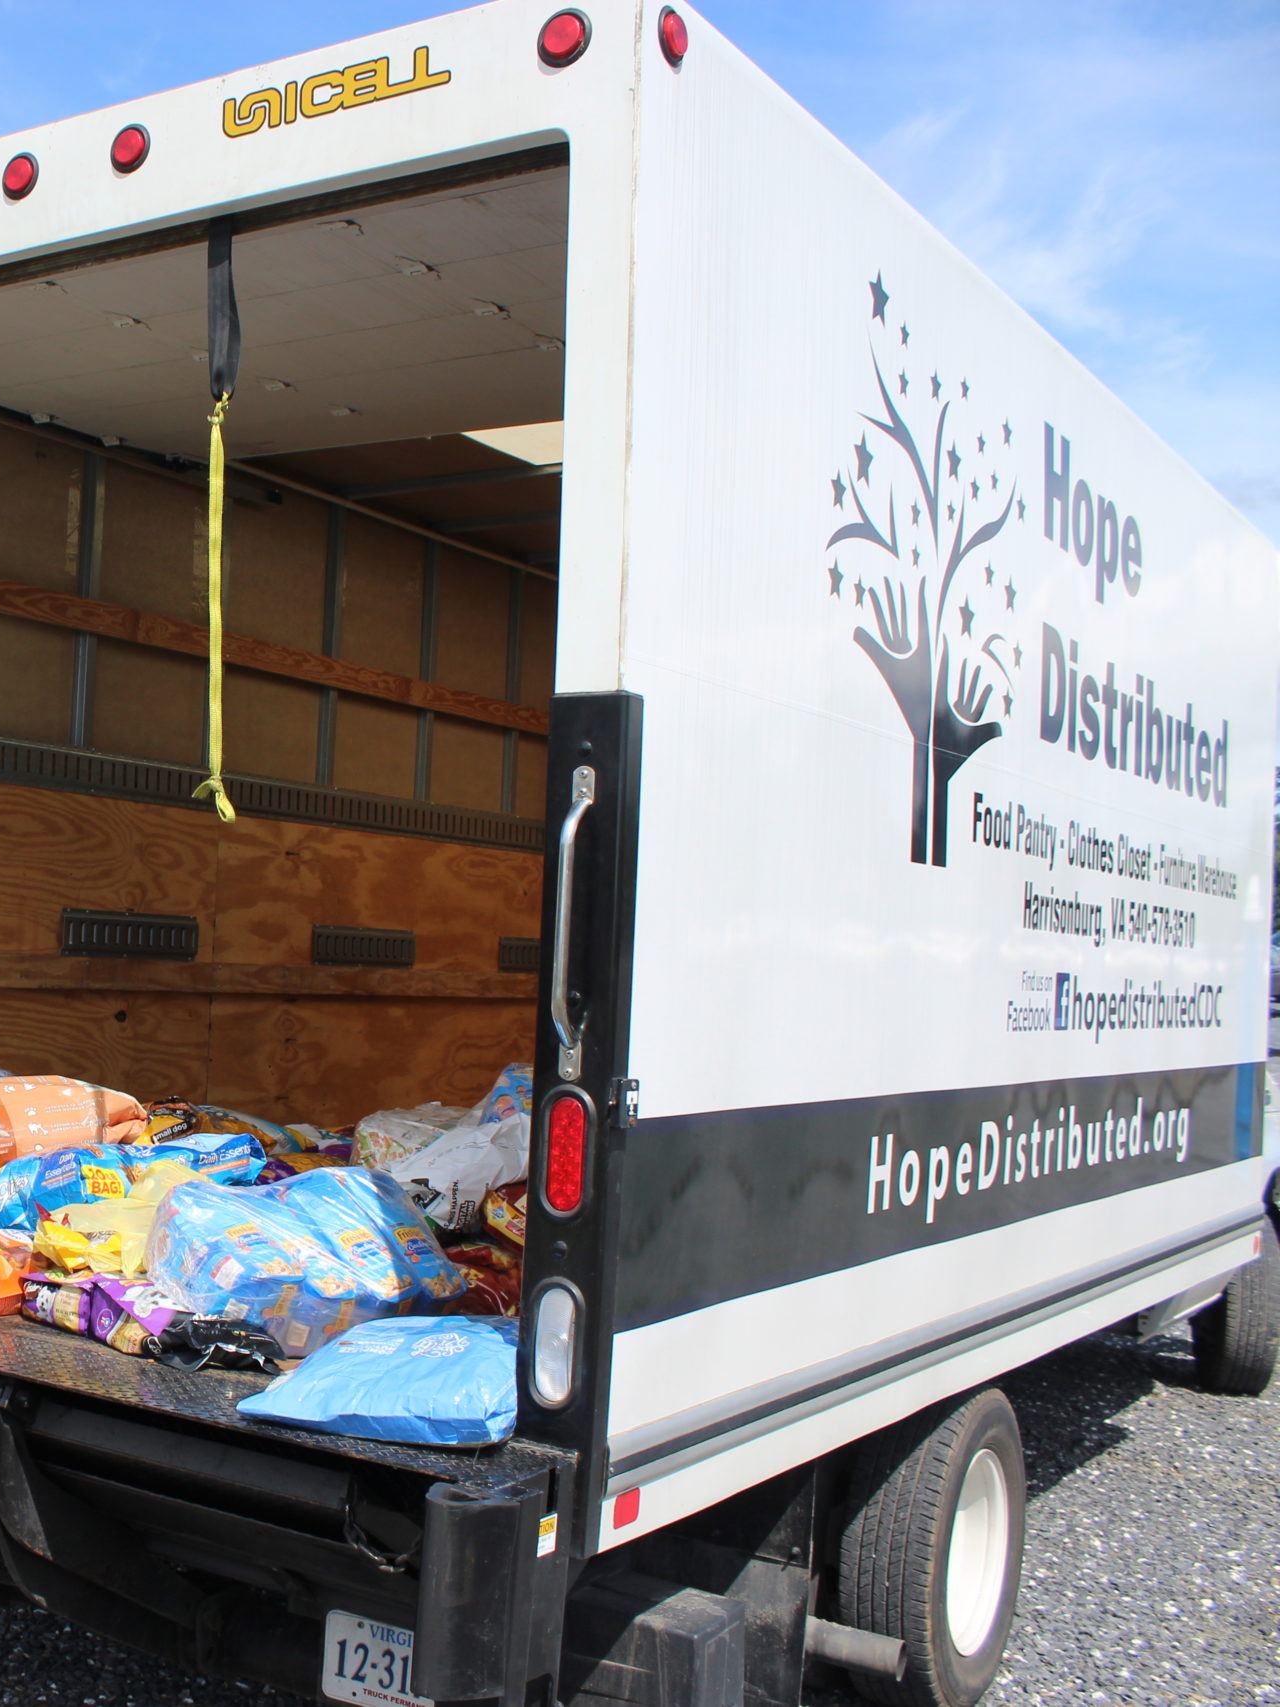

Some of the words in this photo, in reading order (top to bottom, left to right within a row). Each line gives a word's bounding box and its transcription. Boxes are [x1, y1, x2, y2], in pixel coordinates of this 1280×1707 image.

[222, 45, 452, 139] UNICELL
[1043, 420, 1142, 605] Hope
[1039, 620, 1229, 809] Distributed
[972, 791, 1013, 850] Food
[1015, 803, 1057, 871] Pantry
[1067, 819, 1114, 875] Clothes
[1117, 833, 1152, 882] Closet
[1158, 844, 1197, 892] Furniture
[1197, 853, 1238, 900] Warehouse
[1023, 880, 1106, 948] Harrisonburg,
[1110, 896, 1126, 941] VA
[1128, 902, 1197, 950] 540-578-3510
[1022, 970, 1036, 992] Find
[1036, 975, 1044, 992] us
[1044, 976, 1053, 992] on
[1006, 998, 1051, 1032] Facebook
[1071, 975, 1223, 1044] hopedistributedCDC
[153, 1128, 172, 1142] mall
[172, 1121, 188, 1134] dog
[59, 1152, 76, 1165] Daily
[220, 1143, 252, 1161] Essenti
[867, 1096, 1191, 1224] HopeDistributed.org
[92, 1181, 122, 1195] BAG!
[539, 1521, 554, 1535] TION
[369, 1623, 412, 1649] VIRGI
[363, 1687, 389, 1701] TRUCK
